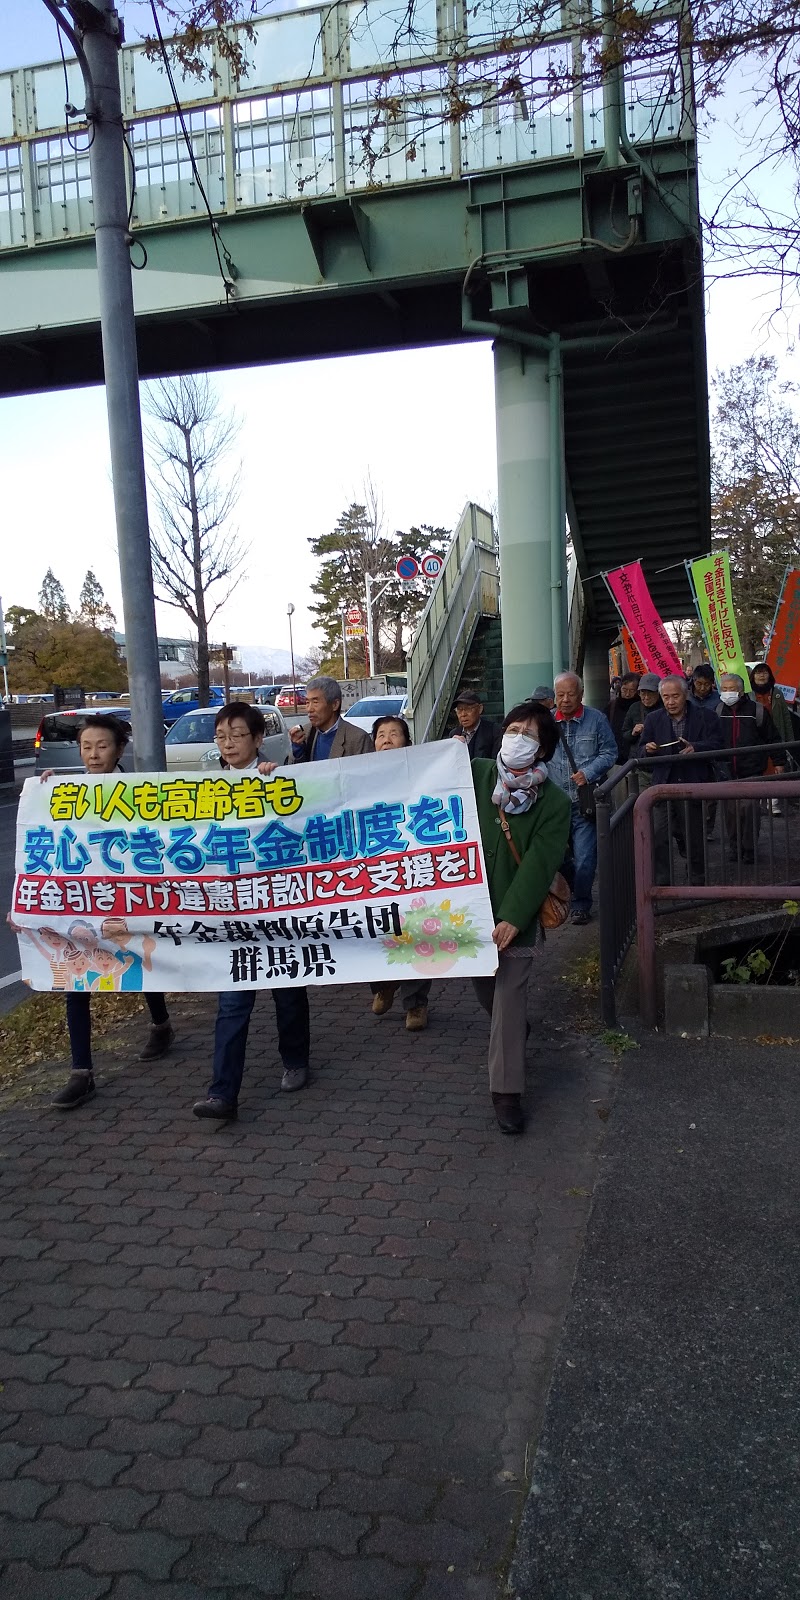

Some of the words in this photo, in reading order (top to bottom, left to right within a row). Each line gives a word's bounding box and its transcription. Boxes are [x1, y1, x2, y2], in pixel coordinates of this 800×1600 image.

[427, 561, 439, 572] 40
[713, 556, 737, 660] 年金引き下げに反対し
[49, 776, 305, 822] 若い人も高齢者も
[24, 794, 469, 876] 安心できる年金制度を!
[17, 846, 478, 914] 年金引き下げ違憲訴訟にご支援を!
[152, 901, 403, 947] 年金裁判原告団
[229, 943, 337, 983] 群馬県
